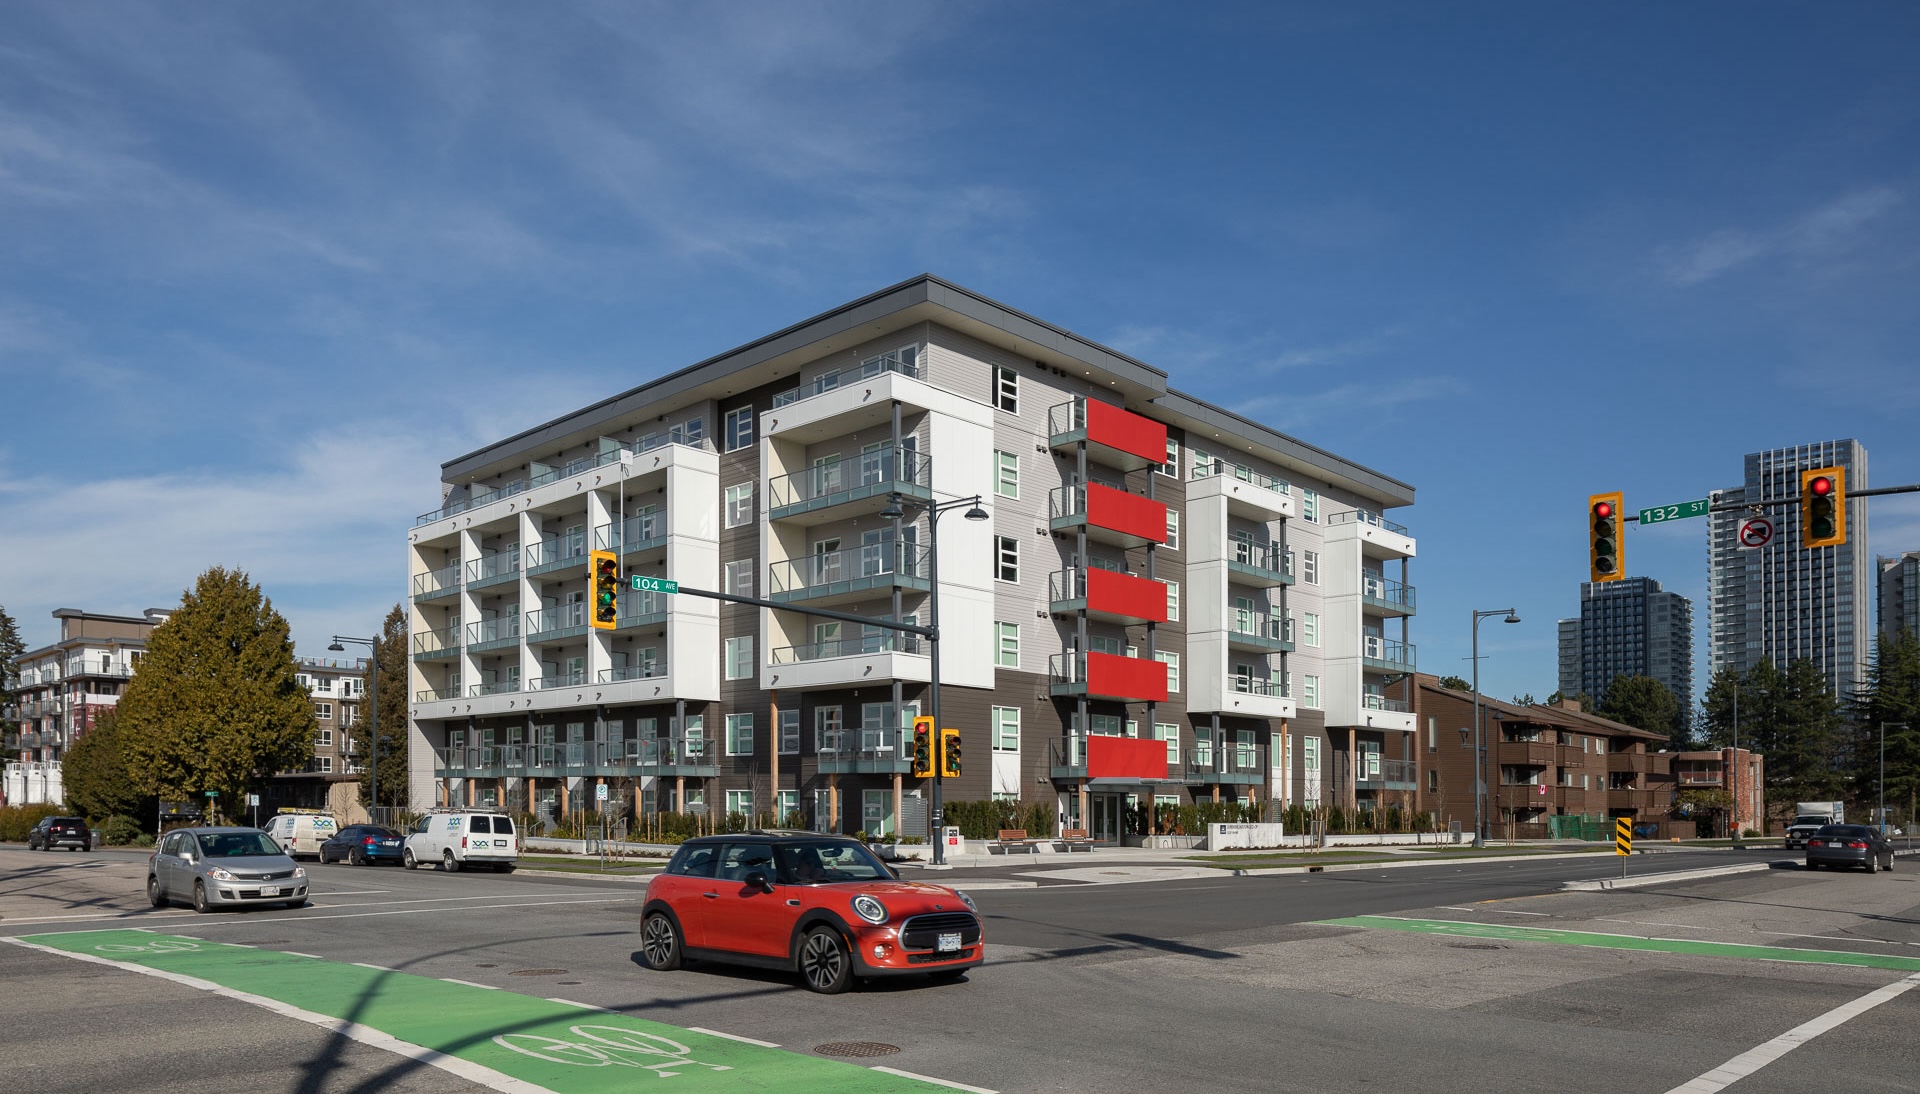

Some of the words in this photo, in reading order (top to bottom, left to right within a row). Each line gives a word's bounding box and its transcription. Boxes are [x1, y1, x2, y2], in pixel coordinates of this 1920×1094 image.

[1643, 506, 1679, 522] 132
[1691, 502, 1704, 511] ST
[635, 578, 659, 590] 104
[665, 582, 676, 590] AVE
